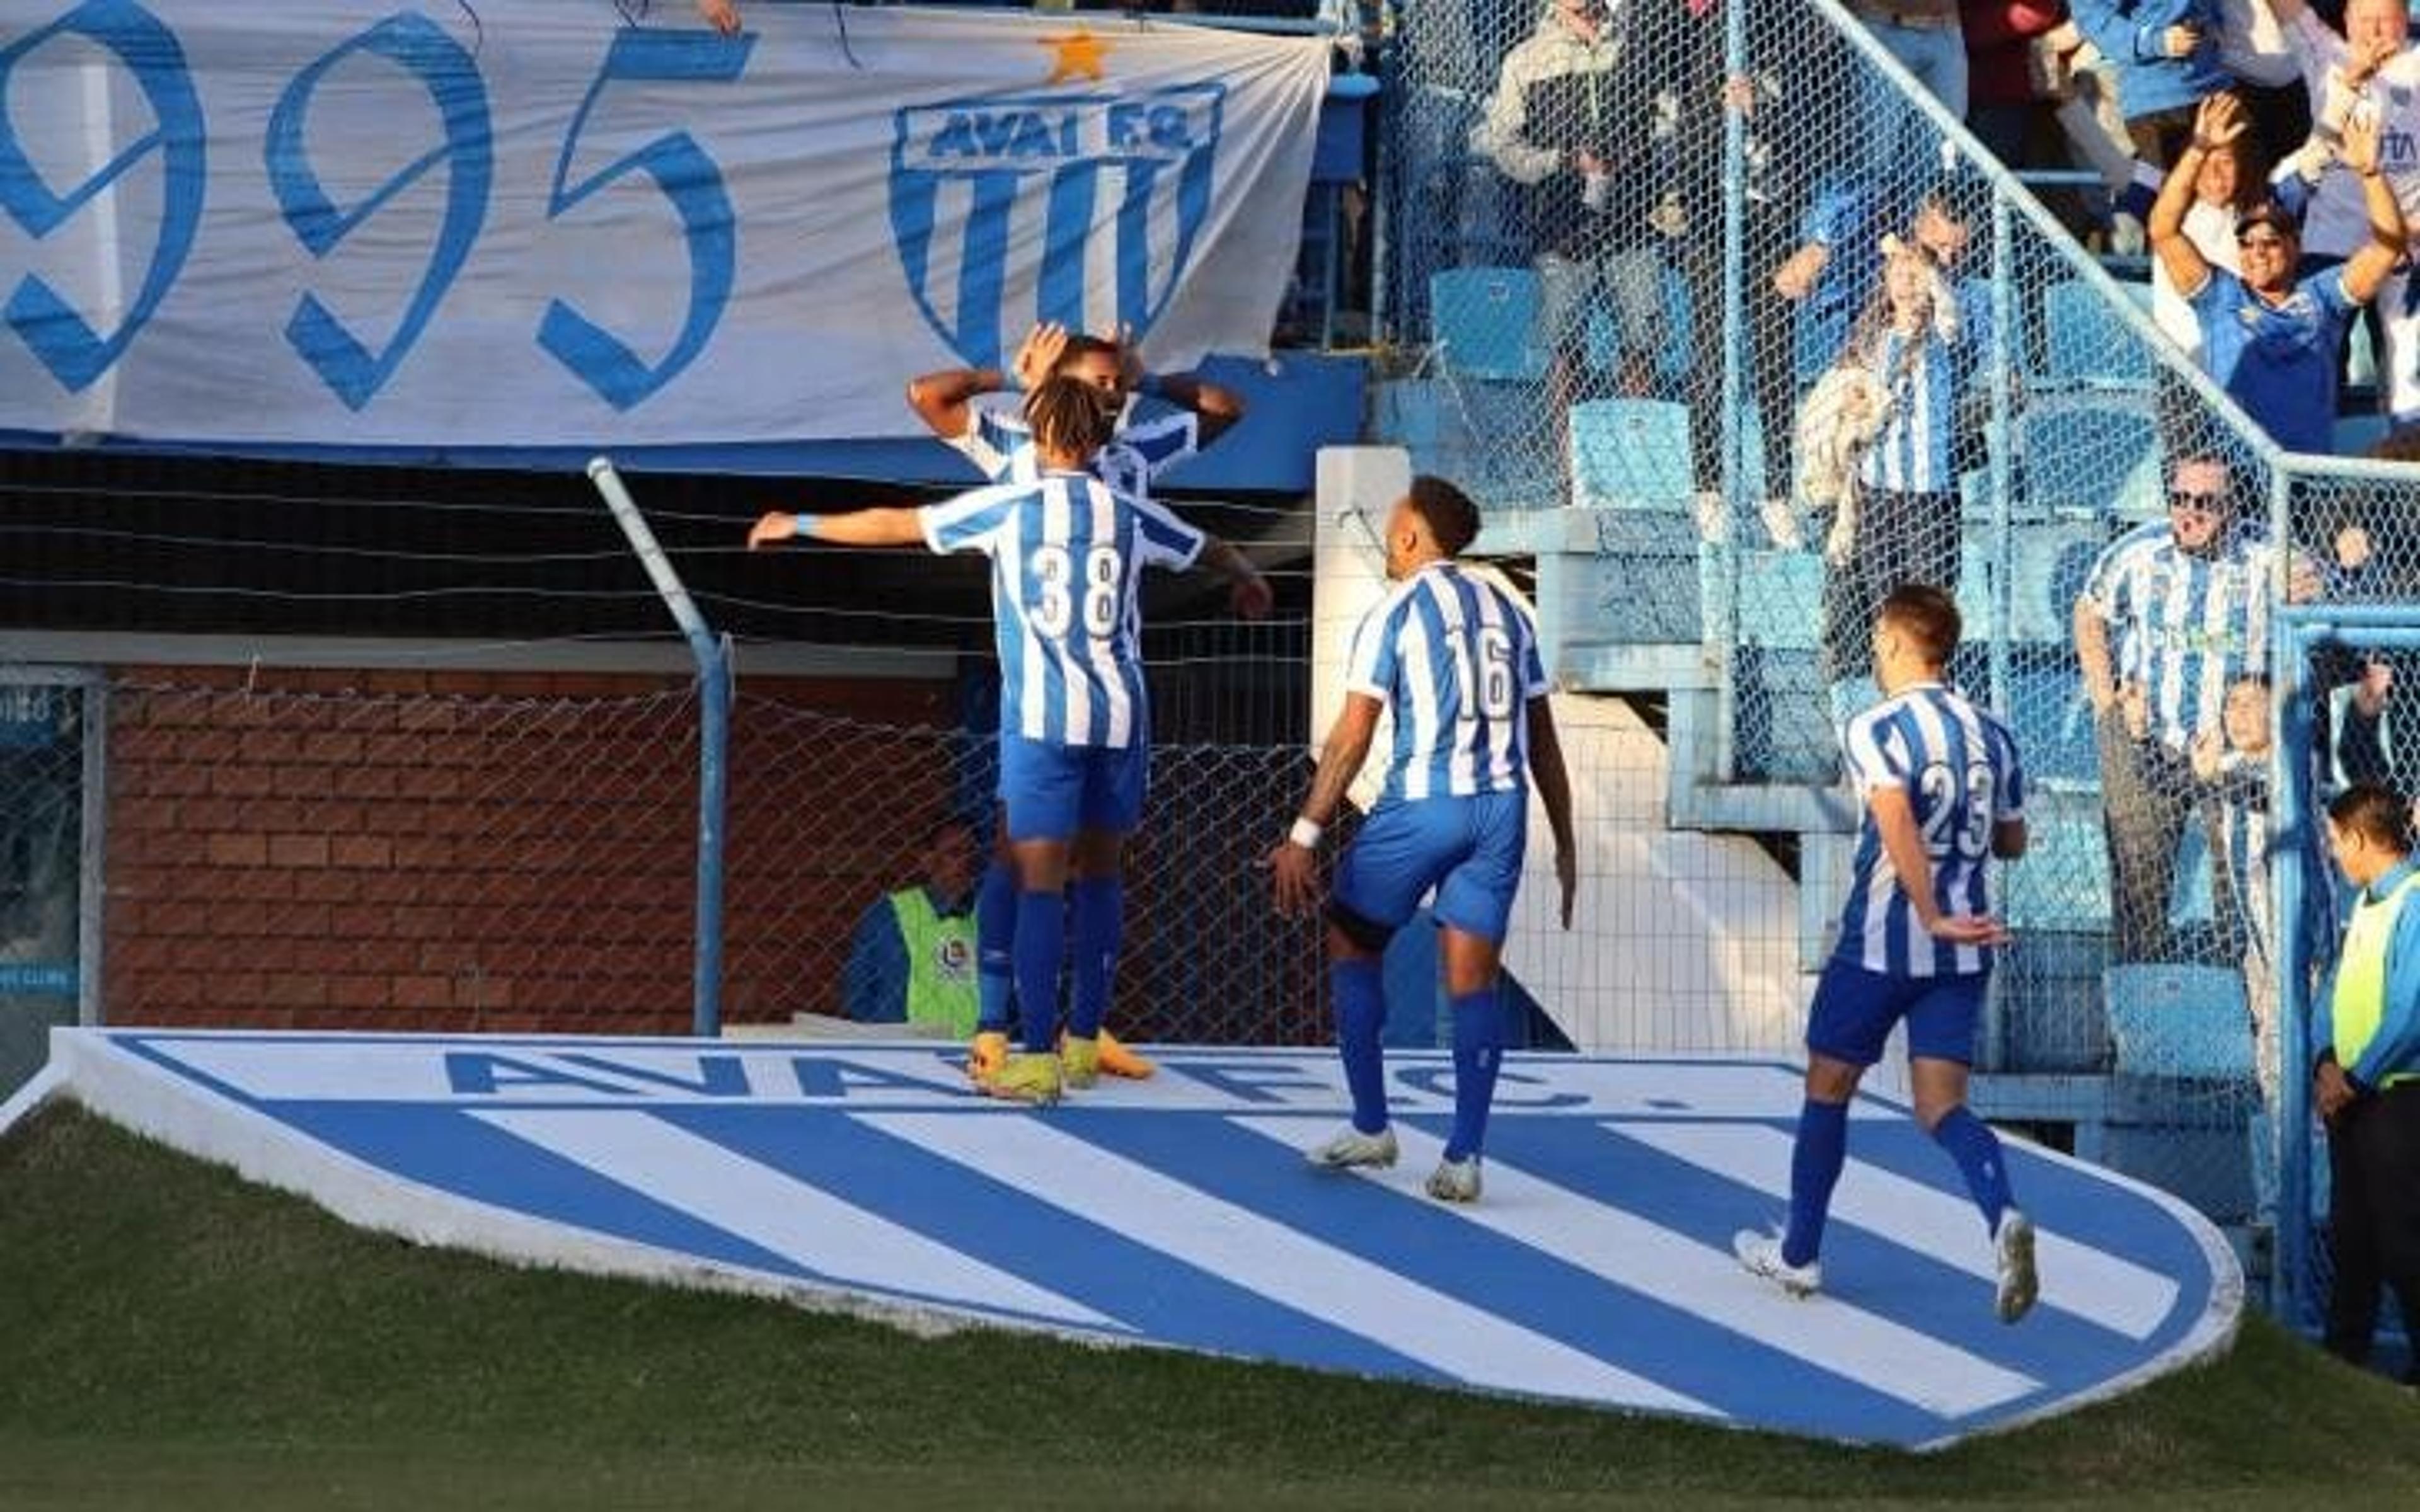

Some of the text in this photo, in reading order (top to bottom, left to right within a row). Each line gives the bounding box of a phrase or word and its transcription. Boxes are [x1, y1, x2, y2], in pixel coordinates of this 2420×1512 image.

[928, 110, 1079, 157] AVAI
[1030, 544, 1122, 640] 38
[1445, 624, 1513, 721] 16
[1920, 761, 1995, 858] 23
[444, 1050, 1073, 1099] AVA
